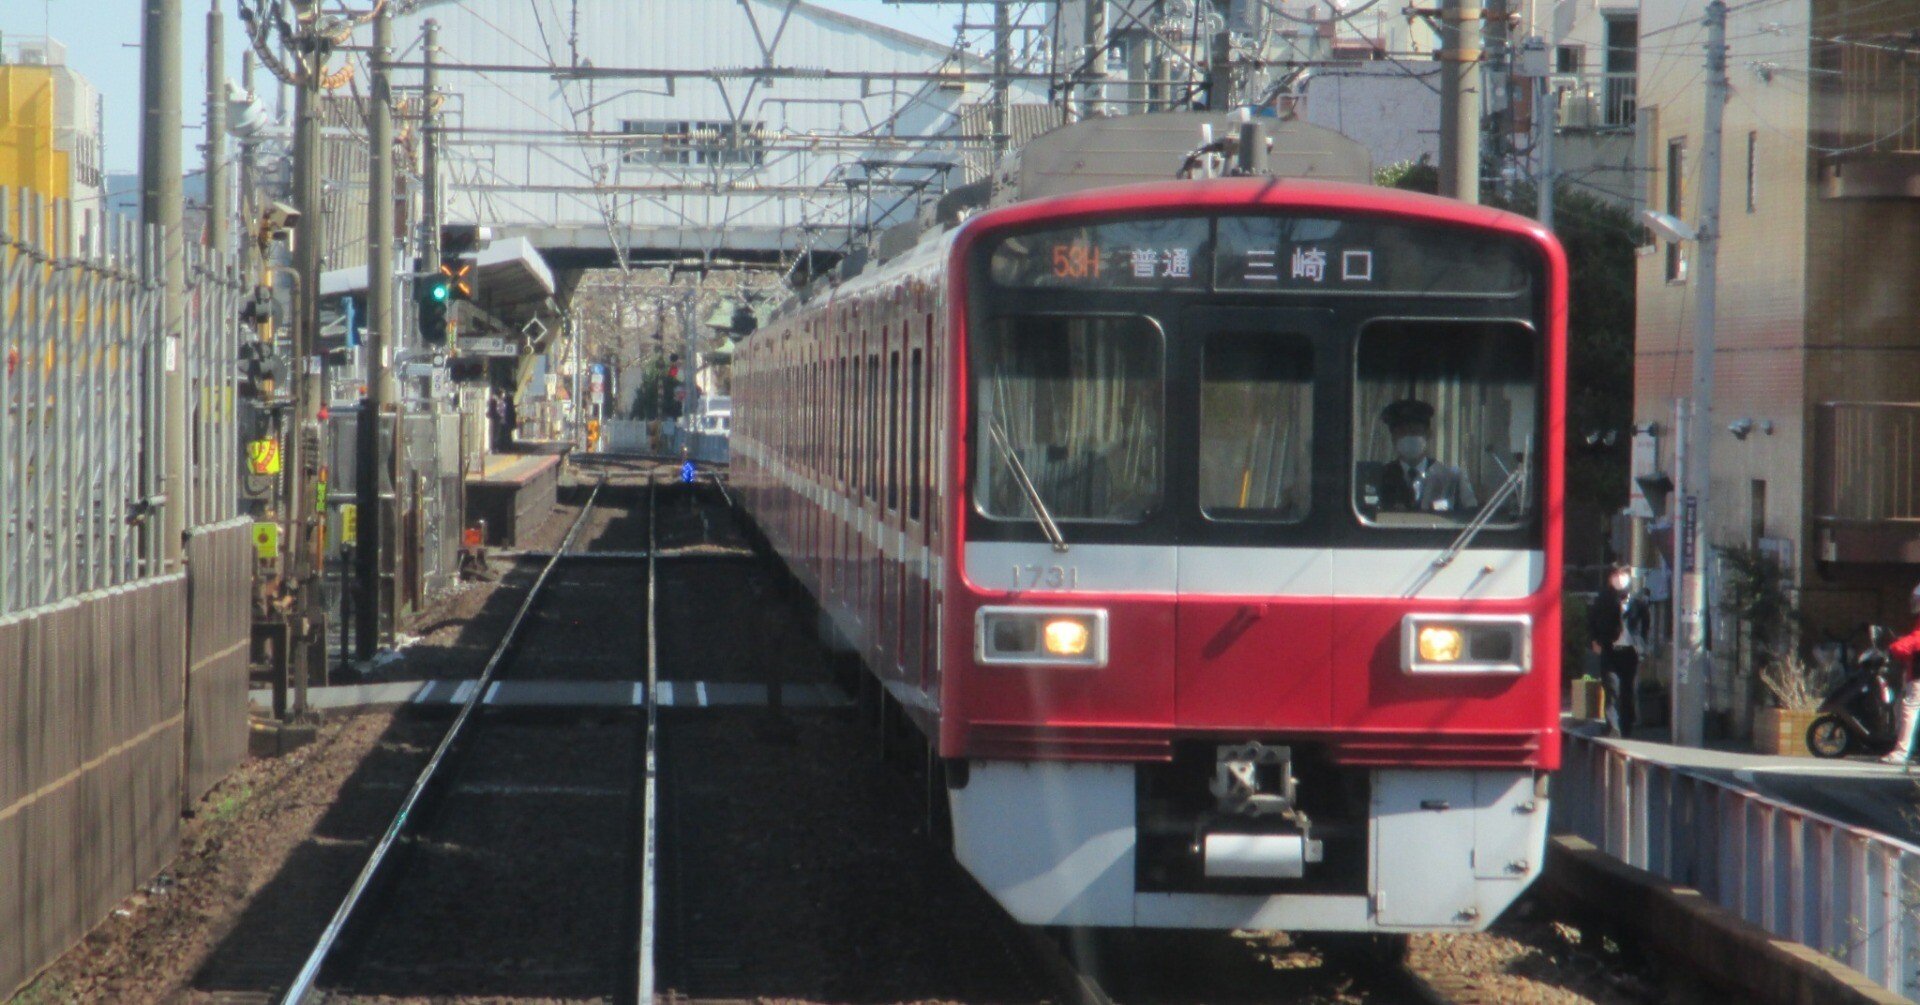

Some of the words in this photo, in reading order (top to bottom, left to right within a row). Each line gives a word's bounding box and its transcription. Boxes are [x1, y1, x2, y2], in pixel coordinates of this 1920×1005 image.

[1053, 246, 1100, 278] 53H
[1130, 248, 1191, 278] 普通
[1243, 247, 1372, 282] 三崎口
[1012, 564, 1078, 589] 1731
